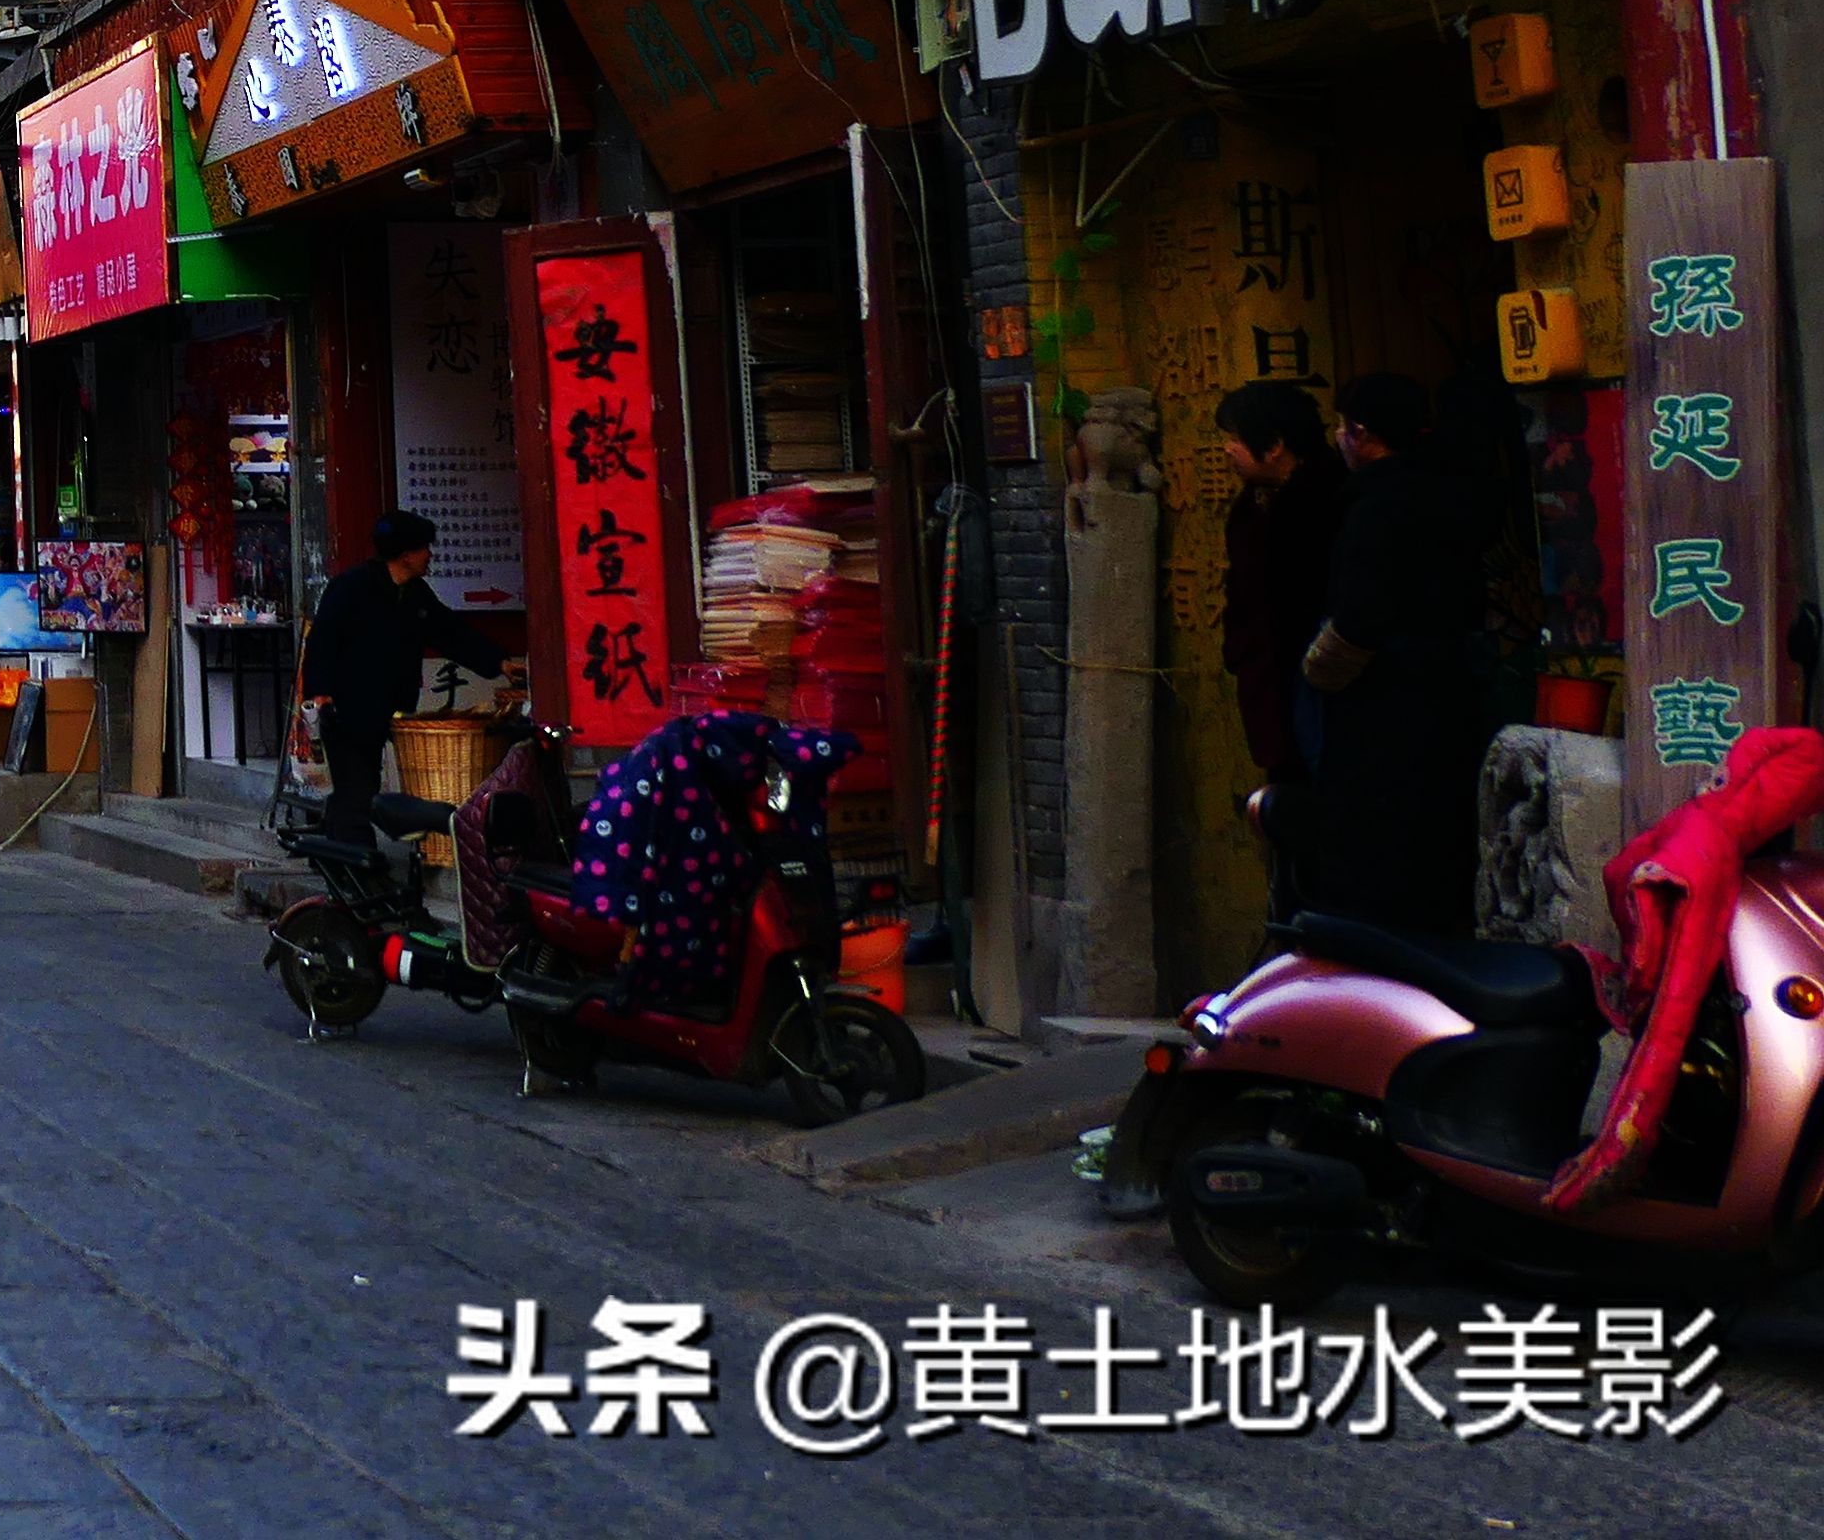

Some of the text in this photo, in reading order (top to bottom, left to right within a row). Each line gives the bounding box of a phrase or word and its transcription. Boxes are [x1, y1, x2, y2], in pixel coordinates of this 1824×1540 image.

[424, 238, 480, 376] 失恋
[555, 303, 664, 708] 安徽宣纸
[1648, 254, 1747, 768] 孫延民藝
